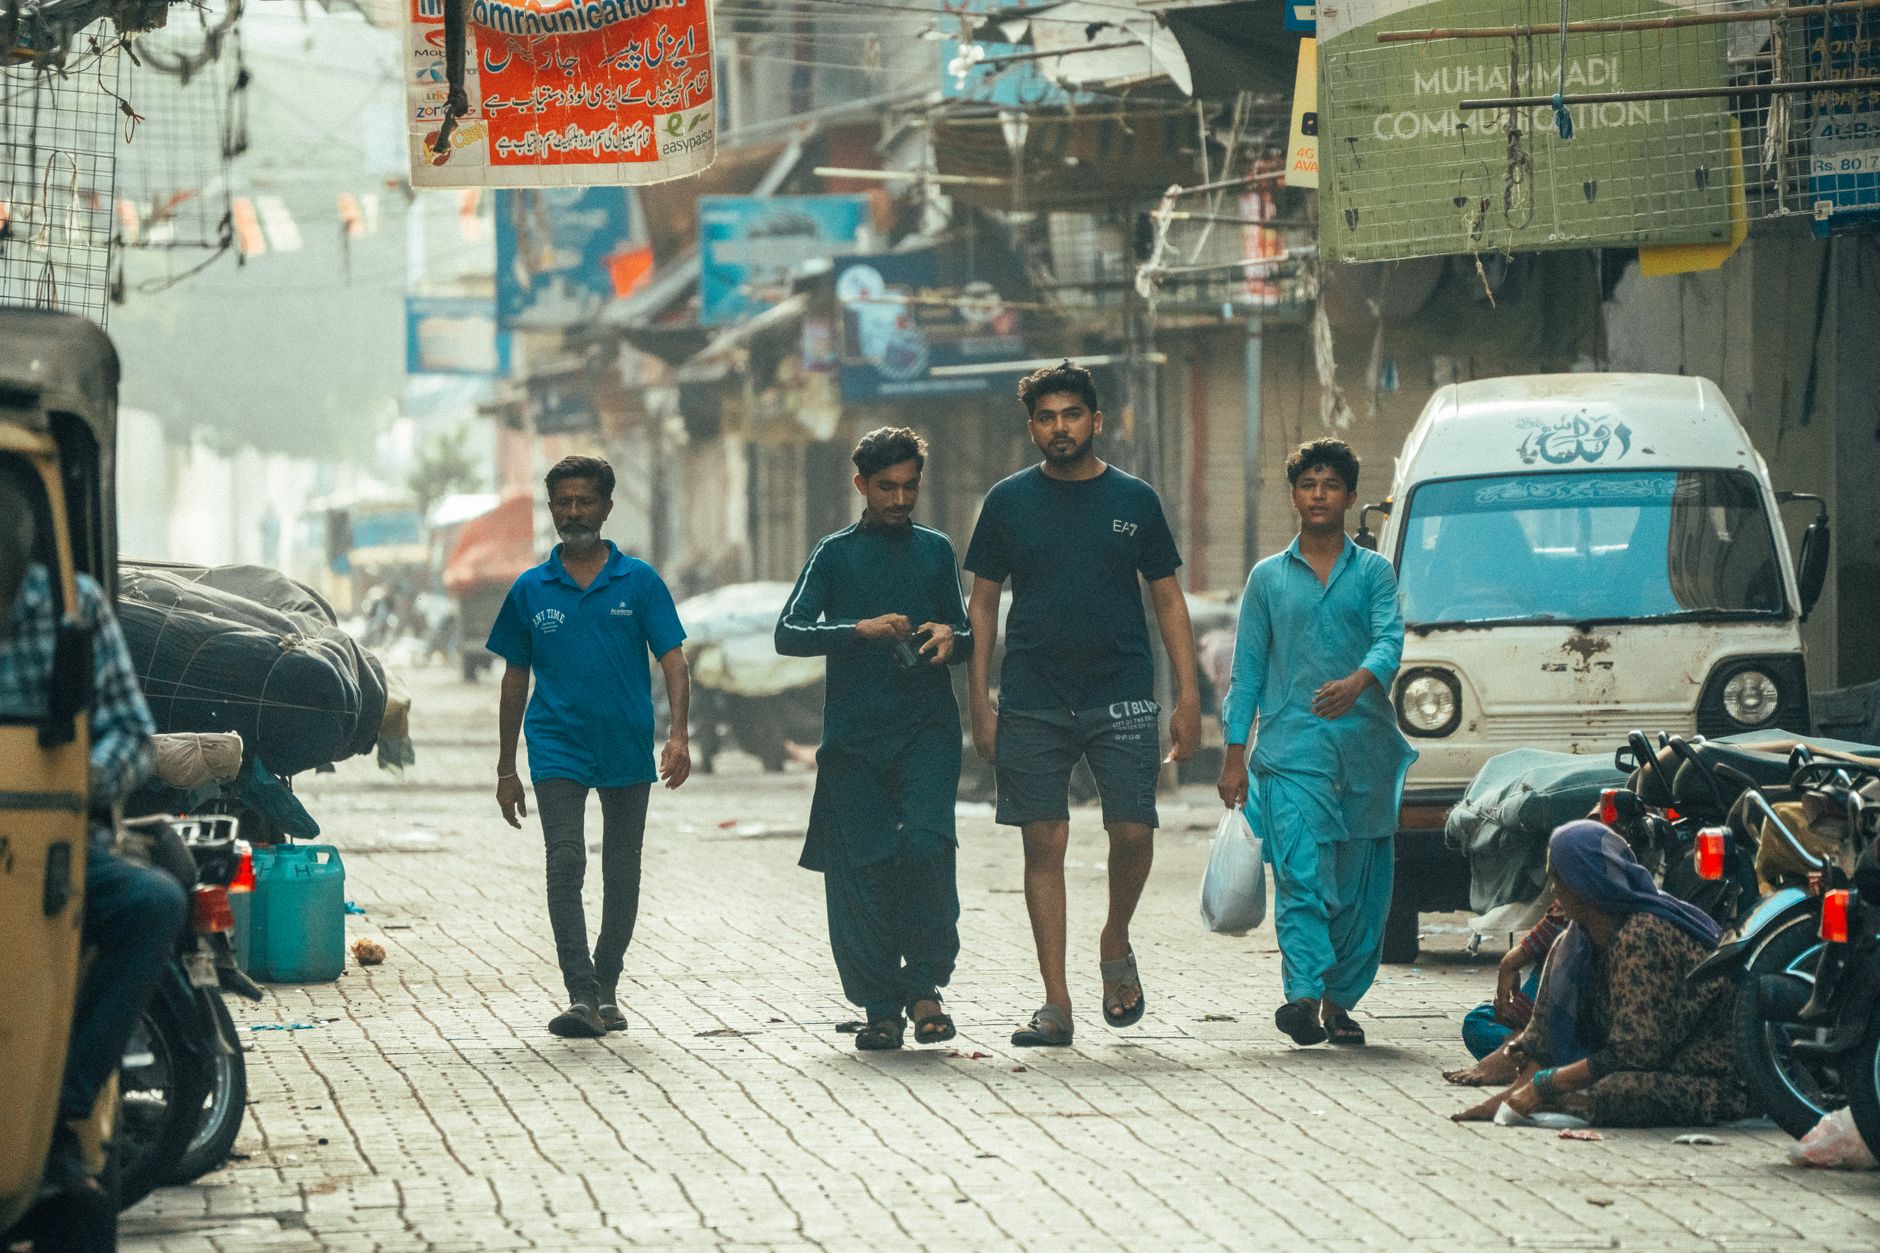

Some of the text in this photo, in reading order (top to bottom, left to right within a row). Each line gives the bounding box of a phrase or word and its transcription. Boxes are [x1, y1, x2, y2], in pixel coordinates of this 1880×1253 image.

[1413, 56, 1618, 96] MUHAMMADI
[661, 130, 713, 155] easypaisa
[1841, 158, 1862, 171] 80
[546, 608, 566, 625] TIME
